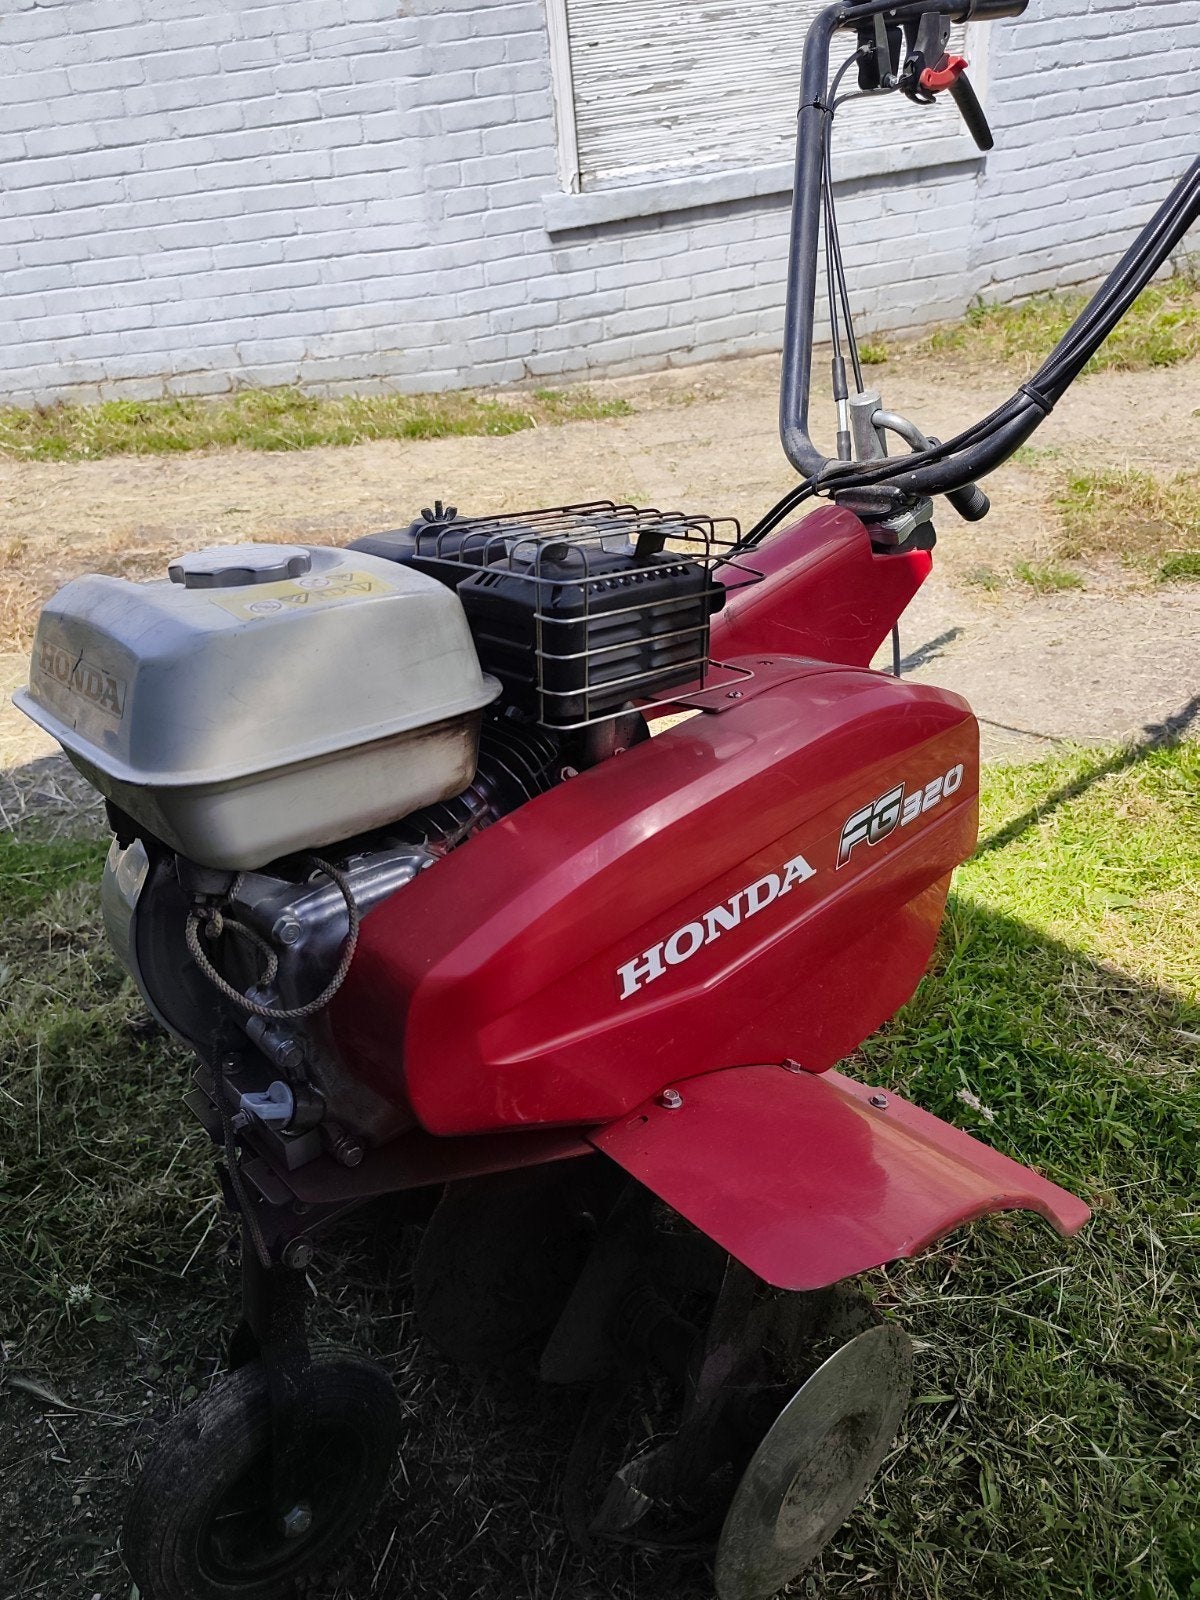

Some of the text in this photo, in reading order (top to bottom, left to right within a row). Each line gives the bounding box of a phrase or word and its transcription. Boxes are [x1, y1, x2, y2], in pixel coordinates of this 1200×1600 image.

[41, 641, 122, 716] HONDA
[616, 763, 965, 1001] HONDA FG320
